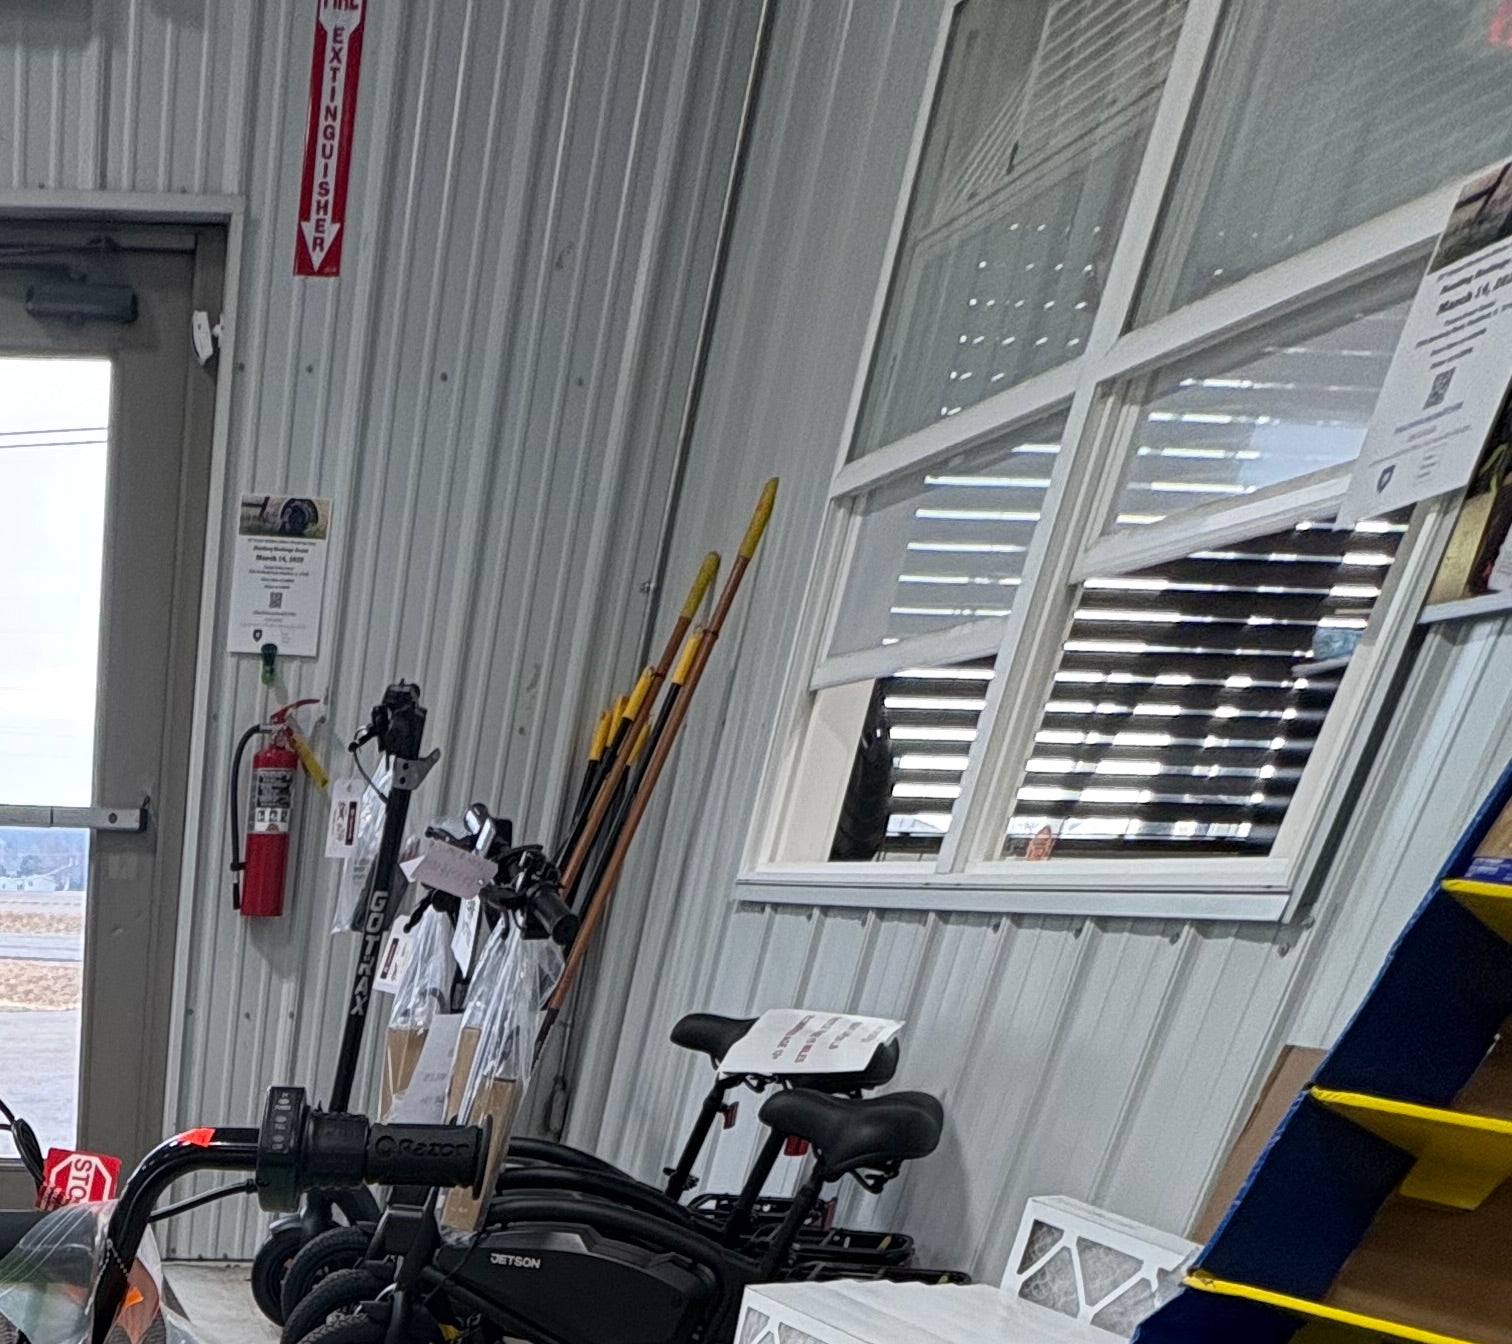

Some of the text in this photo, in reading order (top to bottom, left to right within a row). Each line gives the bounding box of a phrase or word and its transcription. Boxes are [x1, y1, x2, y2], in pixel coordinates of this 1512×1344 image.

[311, 26, 346, 253] EXTINGUISHER
[350, 890, 389, 1017] GOTRAX
[398, 1139, 470, 1157] Razor
[69, 1158, 93, 1204] STO
[490, 1253, 541, 1269] JETSON
